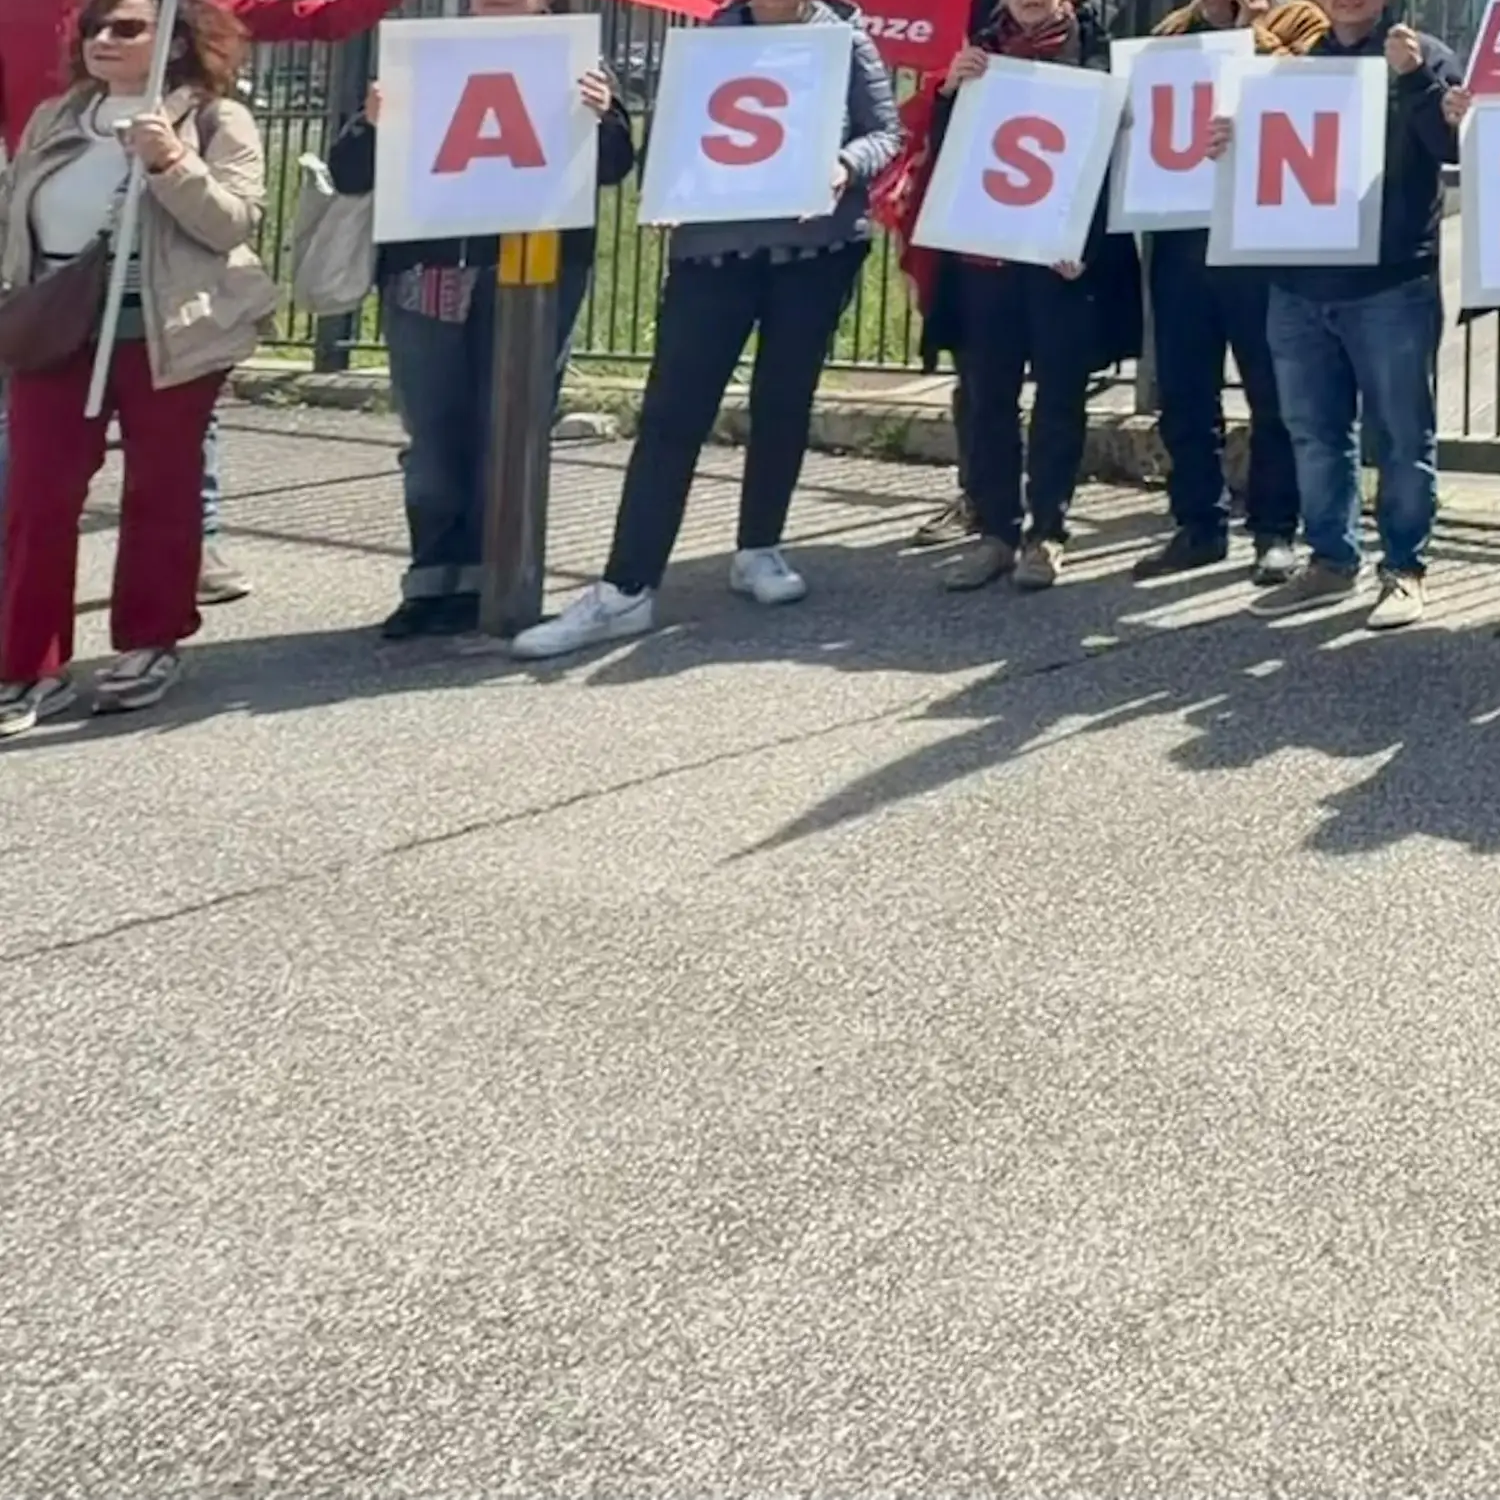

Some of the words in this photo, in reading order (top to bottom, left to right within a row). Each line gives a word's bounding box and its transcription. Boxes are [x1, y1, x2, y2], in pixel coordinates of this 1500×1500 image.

[431, 72, 546, 173] A
[702, 77, 790, 166] S
[982, 116, 1065, 206] S
[1150, 81, 1214, 171] U
[1257, 112, 1339, 206] N
